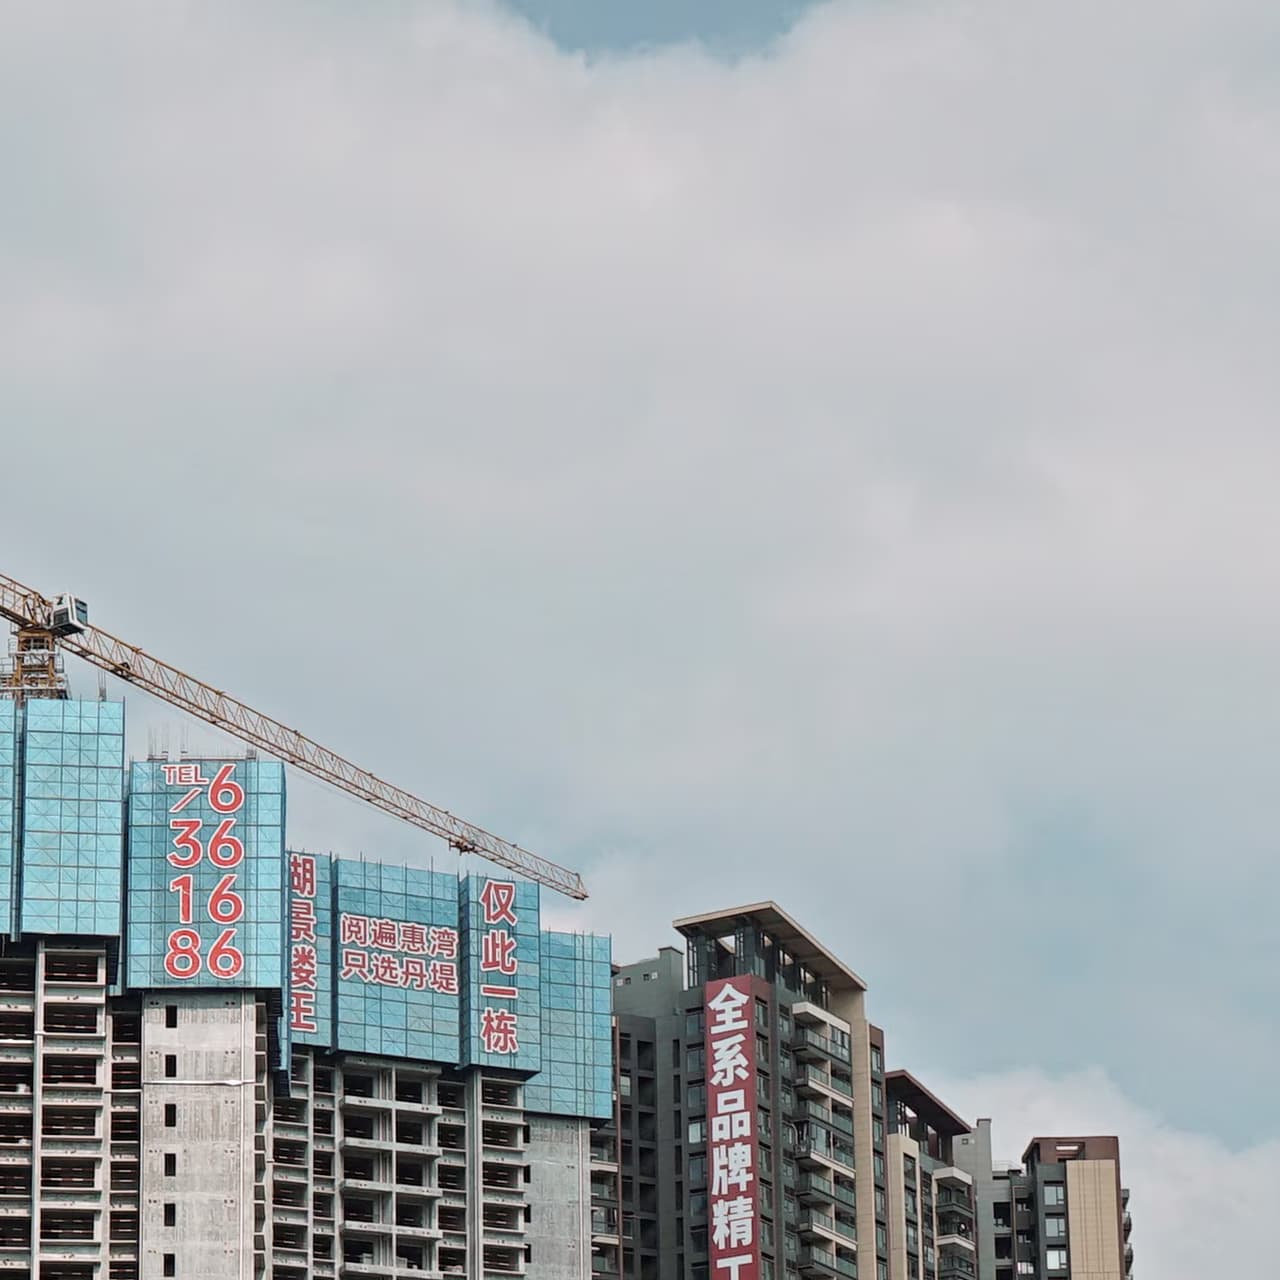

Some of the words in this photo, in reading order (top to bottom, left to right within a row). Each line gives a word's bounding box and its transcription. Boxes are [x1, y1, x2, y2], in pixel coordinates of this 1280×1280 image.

[161, 764, 208, 785] TEL
[339, 913, 458, 961] 阅遍惠湾
[340, 948, 459, 996] 只选丹堤
[479, 879, 518, 1055] 仅此一栋
